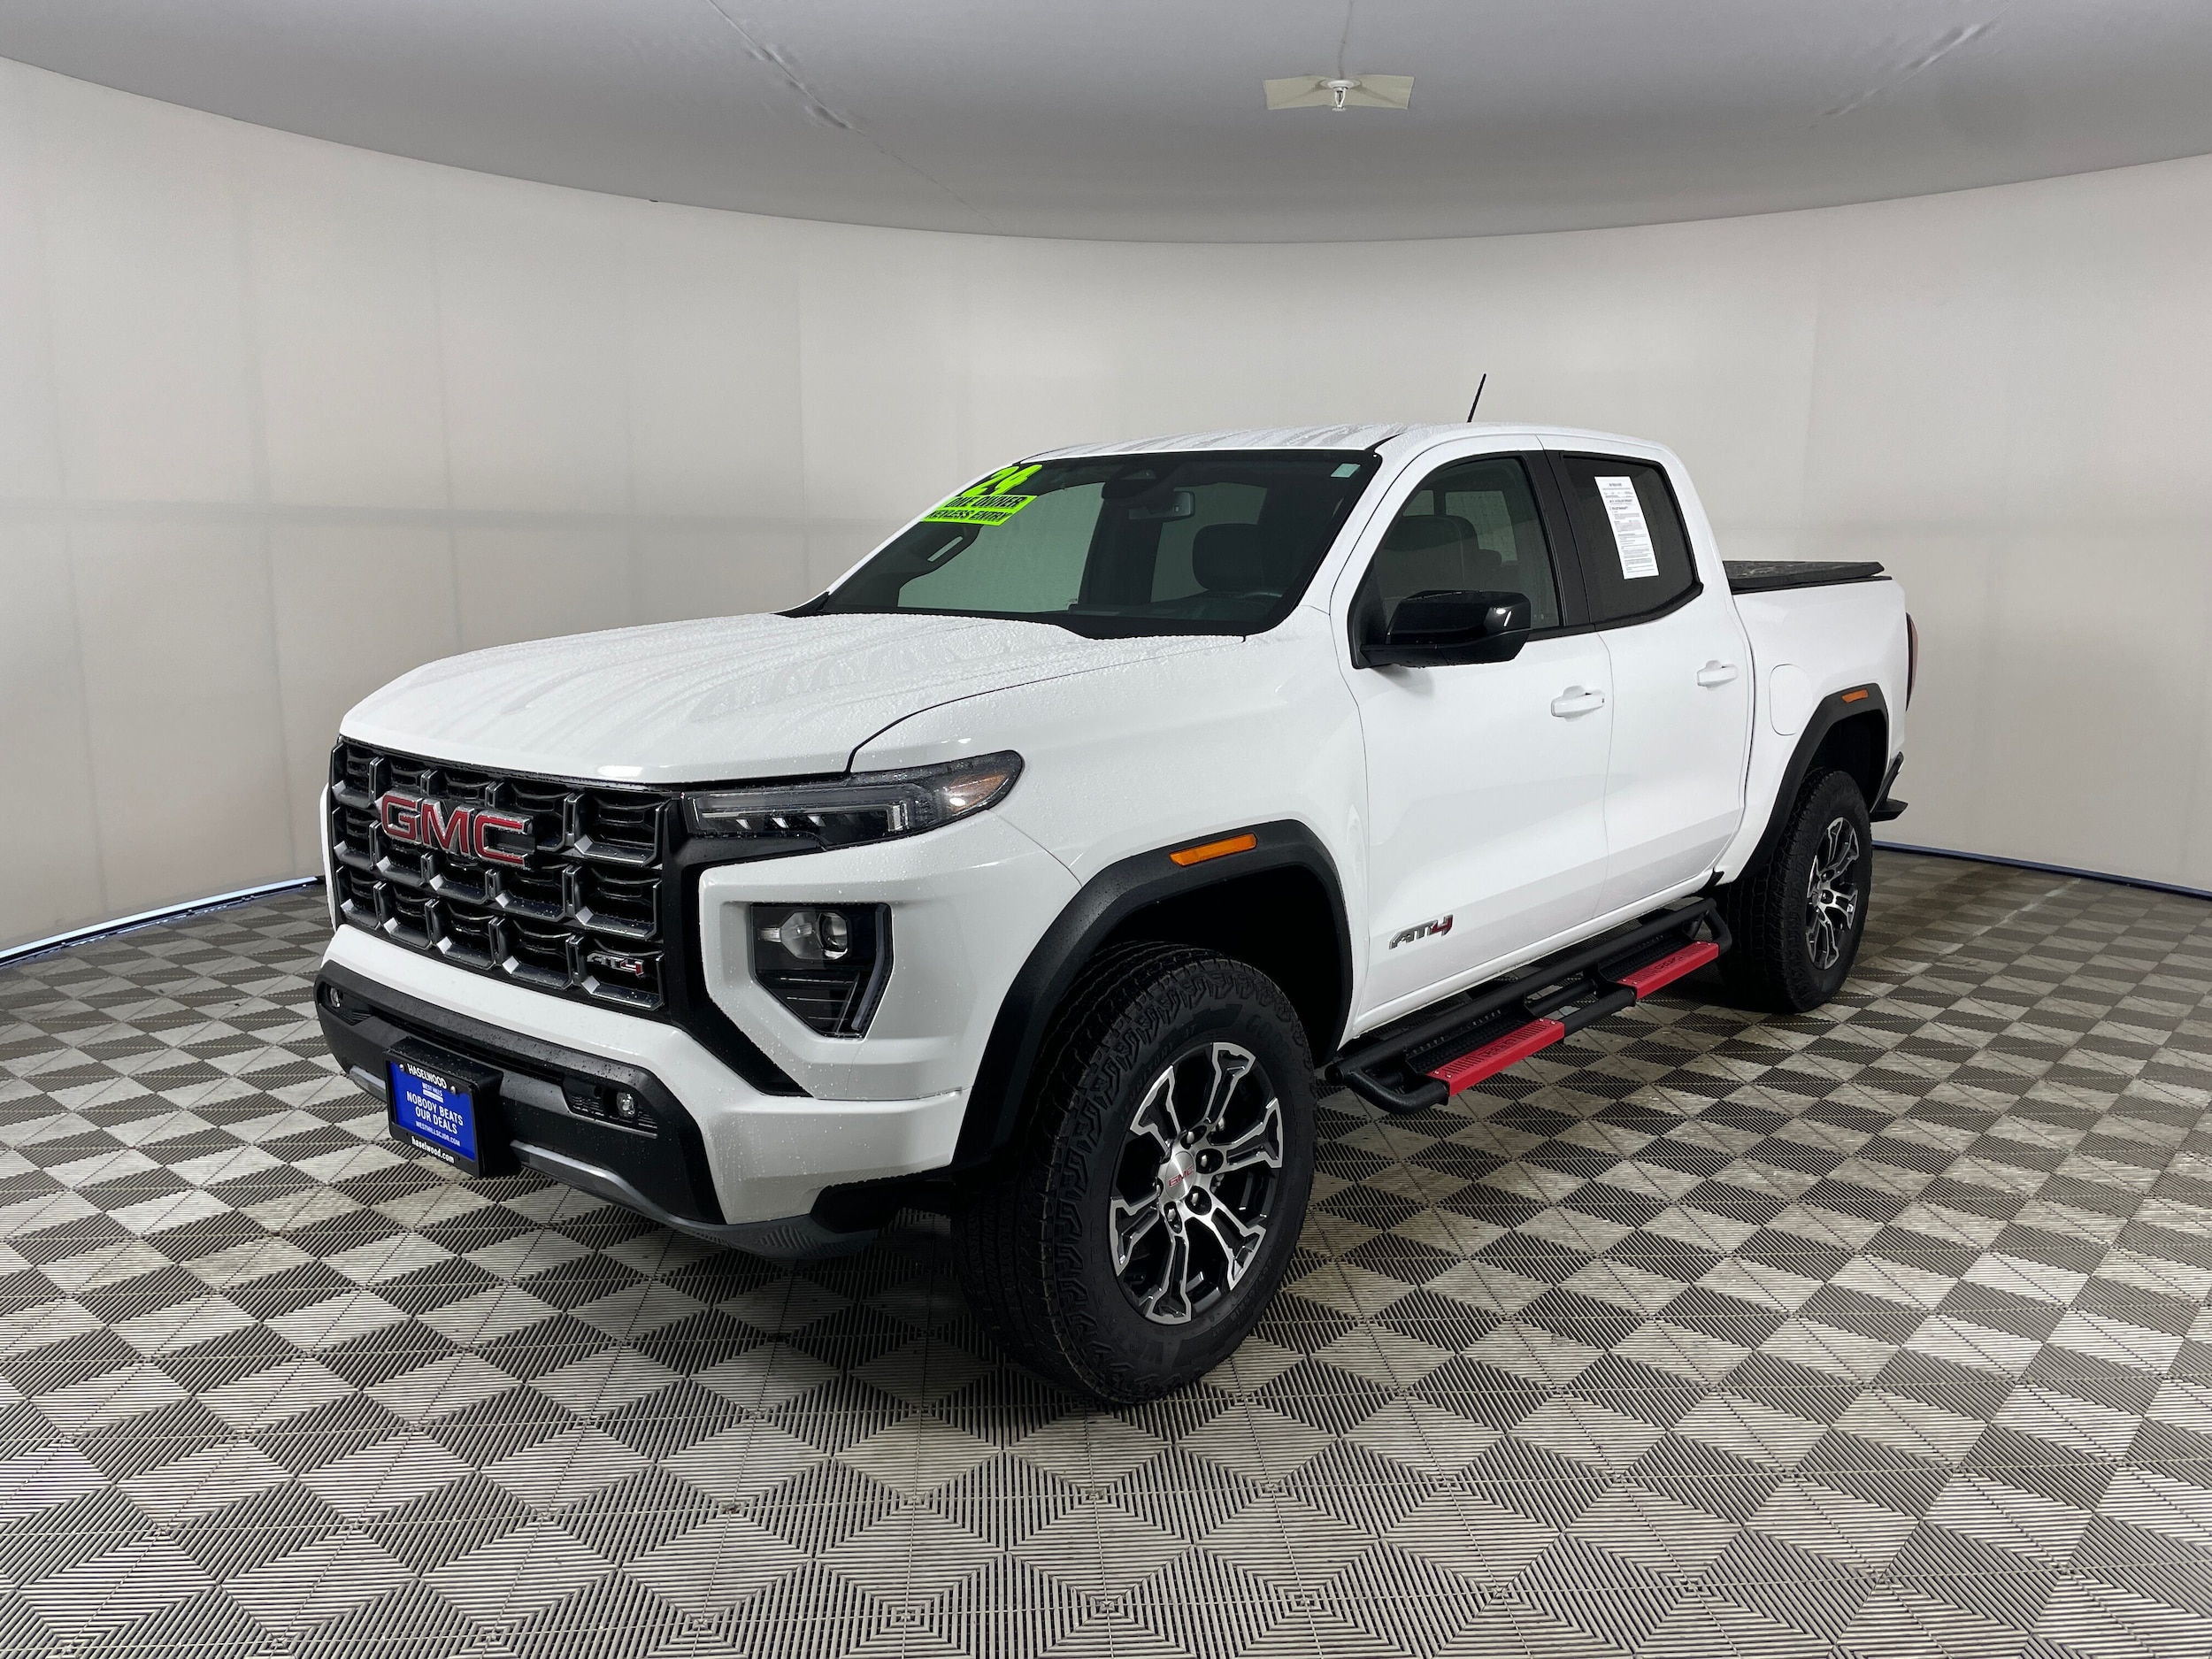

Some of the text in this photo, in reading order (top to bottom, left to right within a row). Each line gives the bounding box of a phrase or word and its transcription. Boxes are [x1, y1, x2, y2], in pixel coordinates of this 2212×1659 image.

[961, 465, 1042, 496] 24
[945, 495, 1028, 509] ONE OWNER
[925, 510, 1012, 522] KEYLESS ENTRY
[381, 789, 534, 868] GMC
[1389, 914, 1454, 949] AT4
[587, 952, 645, 976] AT4
[406, 1063, 447, 1089] HASELWOOD
[422, 1081, 433, 1091] WEST
[433, 1087, 443, 1096] HILLS
[406, 1091, 437, 1114] NOBODY
[439, 1105, 464, 1126] BEATS
[415, 1106, 457, 1134] OUR DEALS
[411, 1136, 455, 1164] haselwood.com
[1169, 1164, 1194, 1187] GMC
